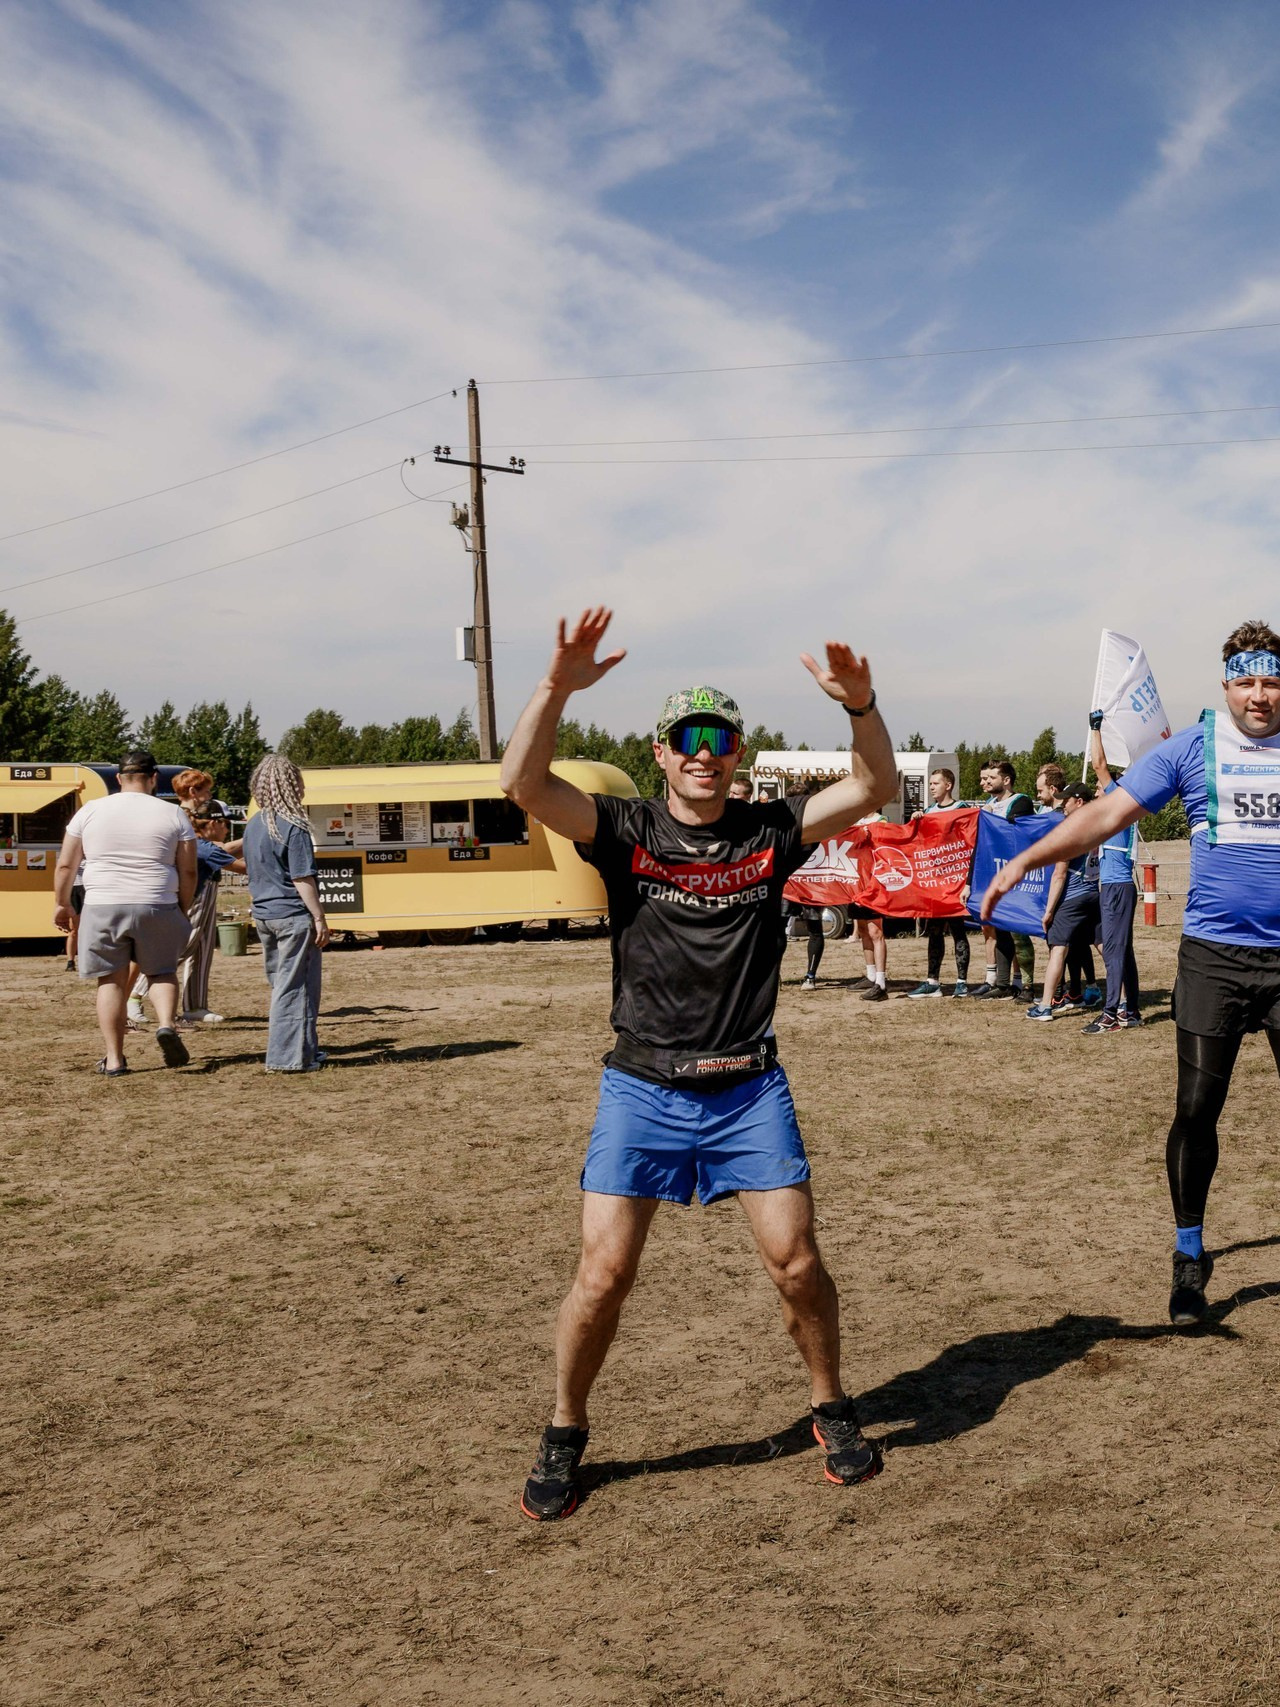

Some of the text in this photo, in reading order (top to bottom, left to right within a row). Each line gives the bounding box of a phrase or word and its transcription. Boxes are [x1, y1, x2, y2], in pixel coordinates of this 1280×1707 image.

[692, 689, 714, 709] LA
[14, 769, 32, 778] Еда
[753, 766, 850, 782] КОФЕ И ВАФ
[368, 852, 393, 861] Кофе
[453, 850, 471, 859] Еда
[317, 868, 354, 878] SUN OF
[638, 854, 769, 892] ИТРУКТОР
[318, 881, 327, 891] A
[919, 879, 938, 888] ГУП
[318, 893, 355, 903] BEACH
[637, 880, 769, 909] ГОНКА ГЕРОЕВ
[697, 1055, 751, 1067] ИНСТРУКТОР
[696, 1065, 724, 1074] ГОНКА
